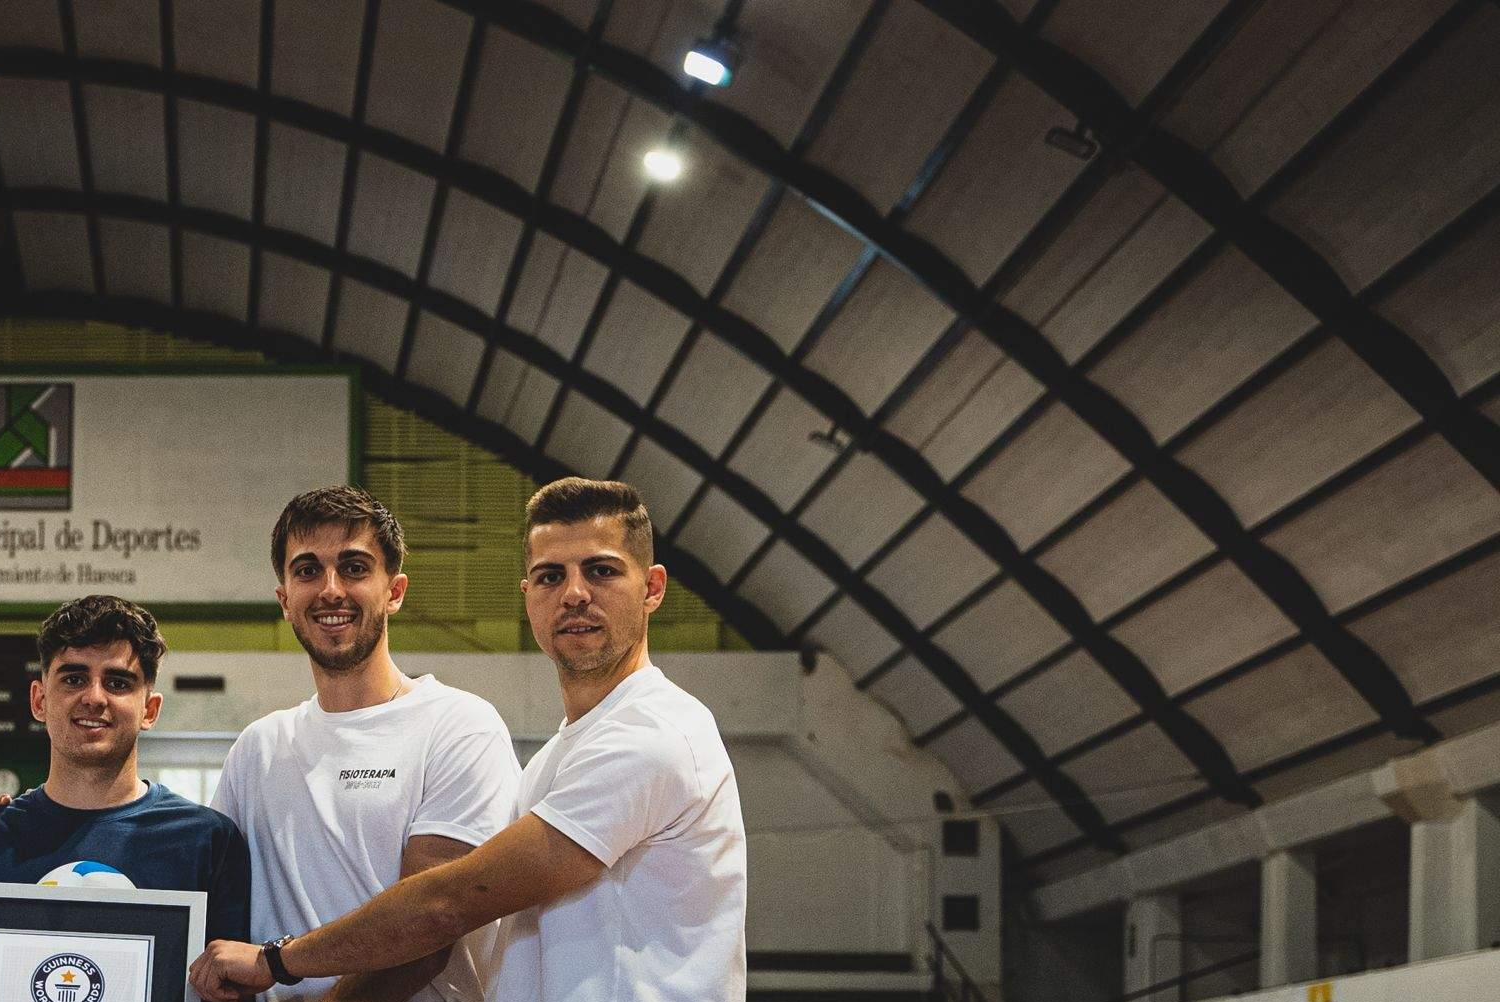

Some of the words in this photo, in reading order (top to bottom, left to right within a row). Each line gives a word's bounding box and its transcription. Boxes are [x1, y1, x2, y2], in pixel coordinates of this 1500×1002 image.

[54, 519, 84, 550] de
[92, 519, 201, 558] Deportes
[57, 561, 74, 584] de
[77, 562, 137, 584] Huesca
[339, 768, 396, 780] FISIOTERAPIA
[42, 957, 96, 976] GUINNESS
